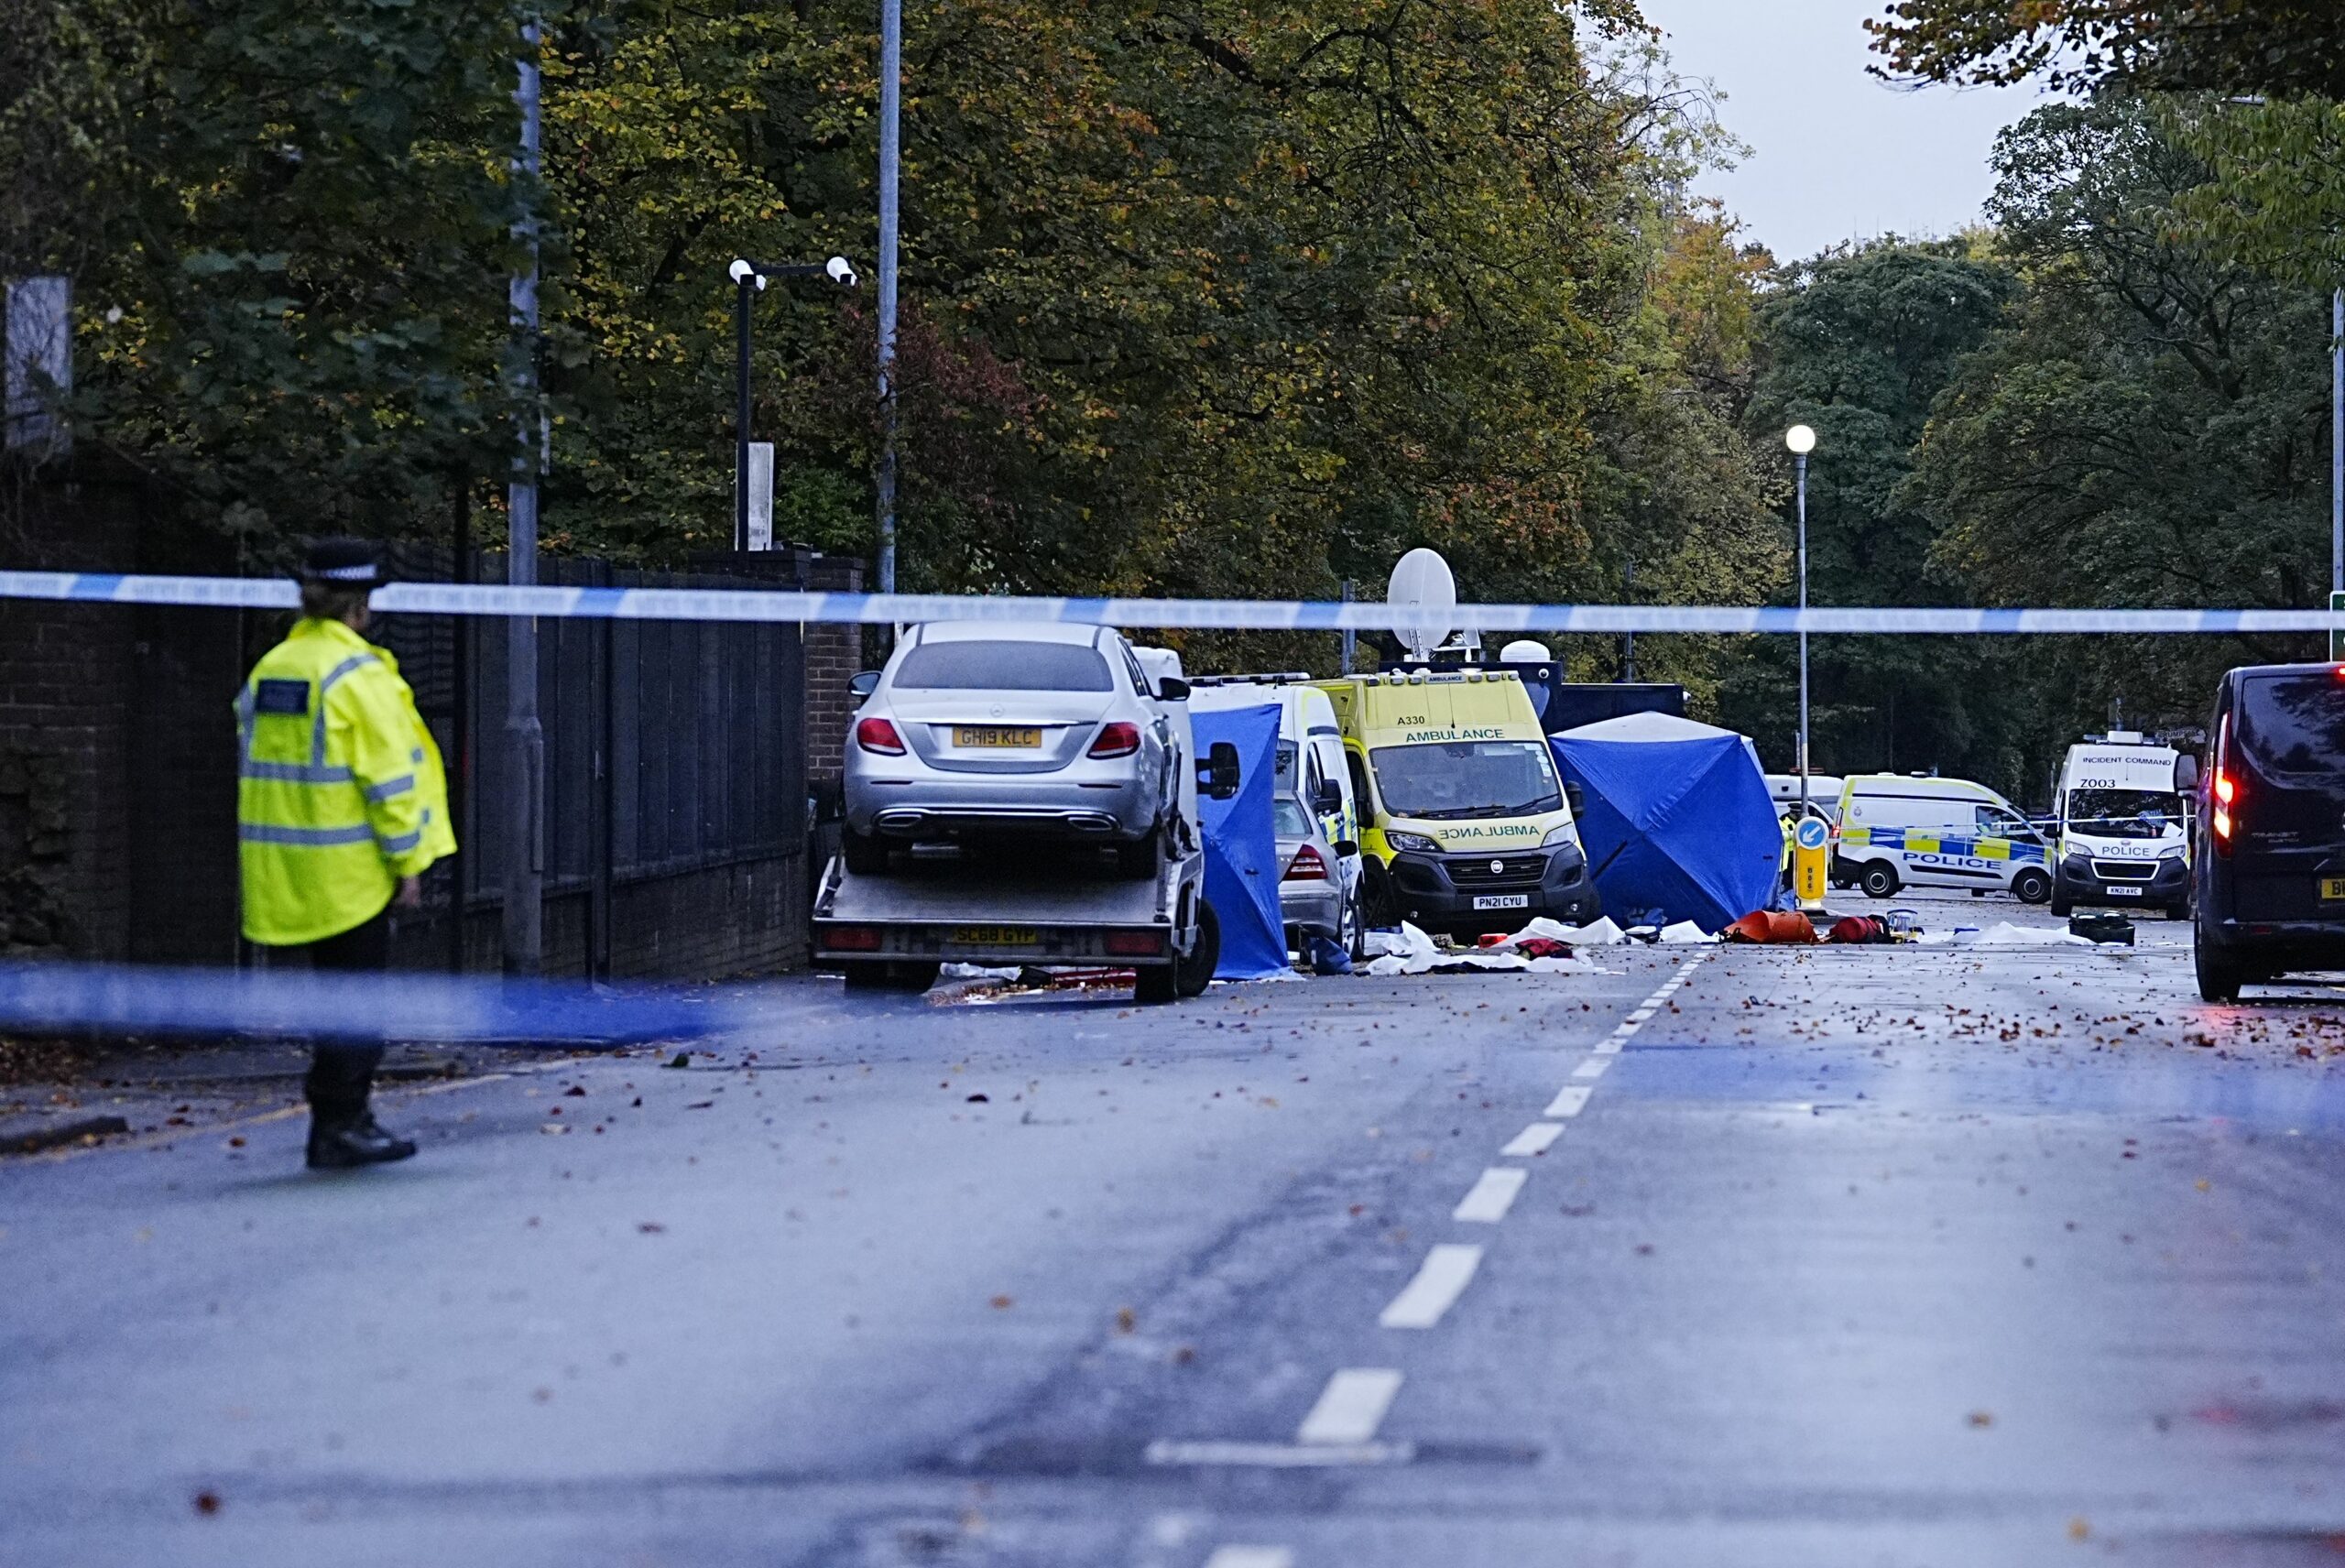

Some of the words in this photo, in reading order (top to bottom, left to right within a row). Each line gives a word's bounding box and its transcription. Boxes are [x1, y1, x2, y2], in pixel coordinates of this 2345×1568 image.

[1397, 715, 1425, 725] A330
[962, 730, 997, 744] GH19
[1001, 730, 1032, 745] KLC
[1406, 728, 1505, 743] AMBULANCE
[2125, 757, 2172, 767] COMMAND
[2102, 846, 2150, 856] POLICE
[1903, 852, 2002, 870] POLICE
[1479, 898, 1500, 908] PN21
[1502, 897, 1522, 907] CYU
